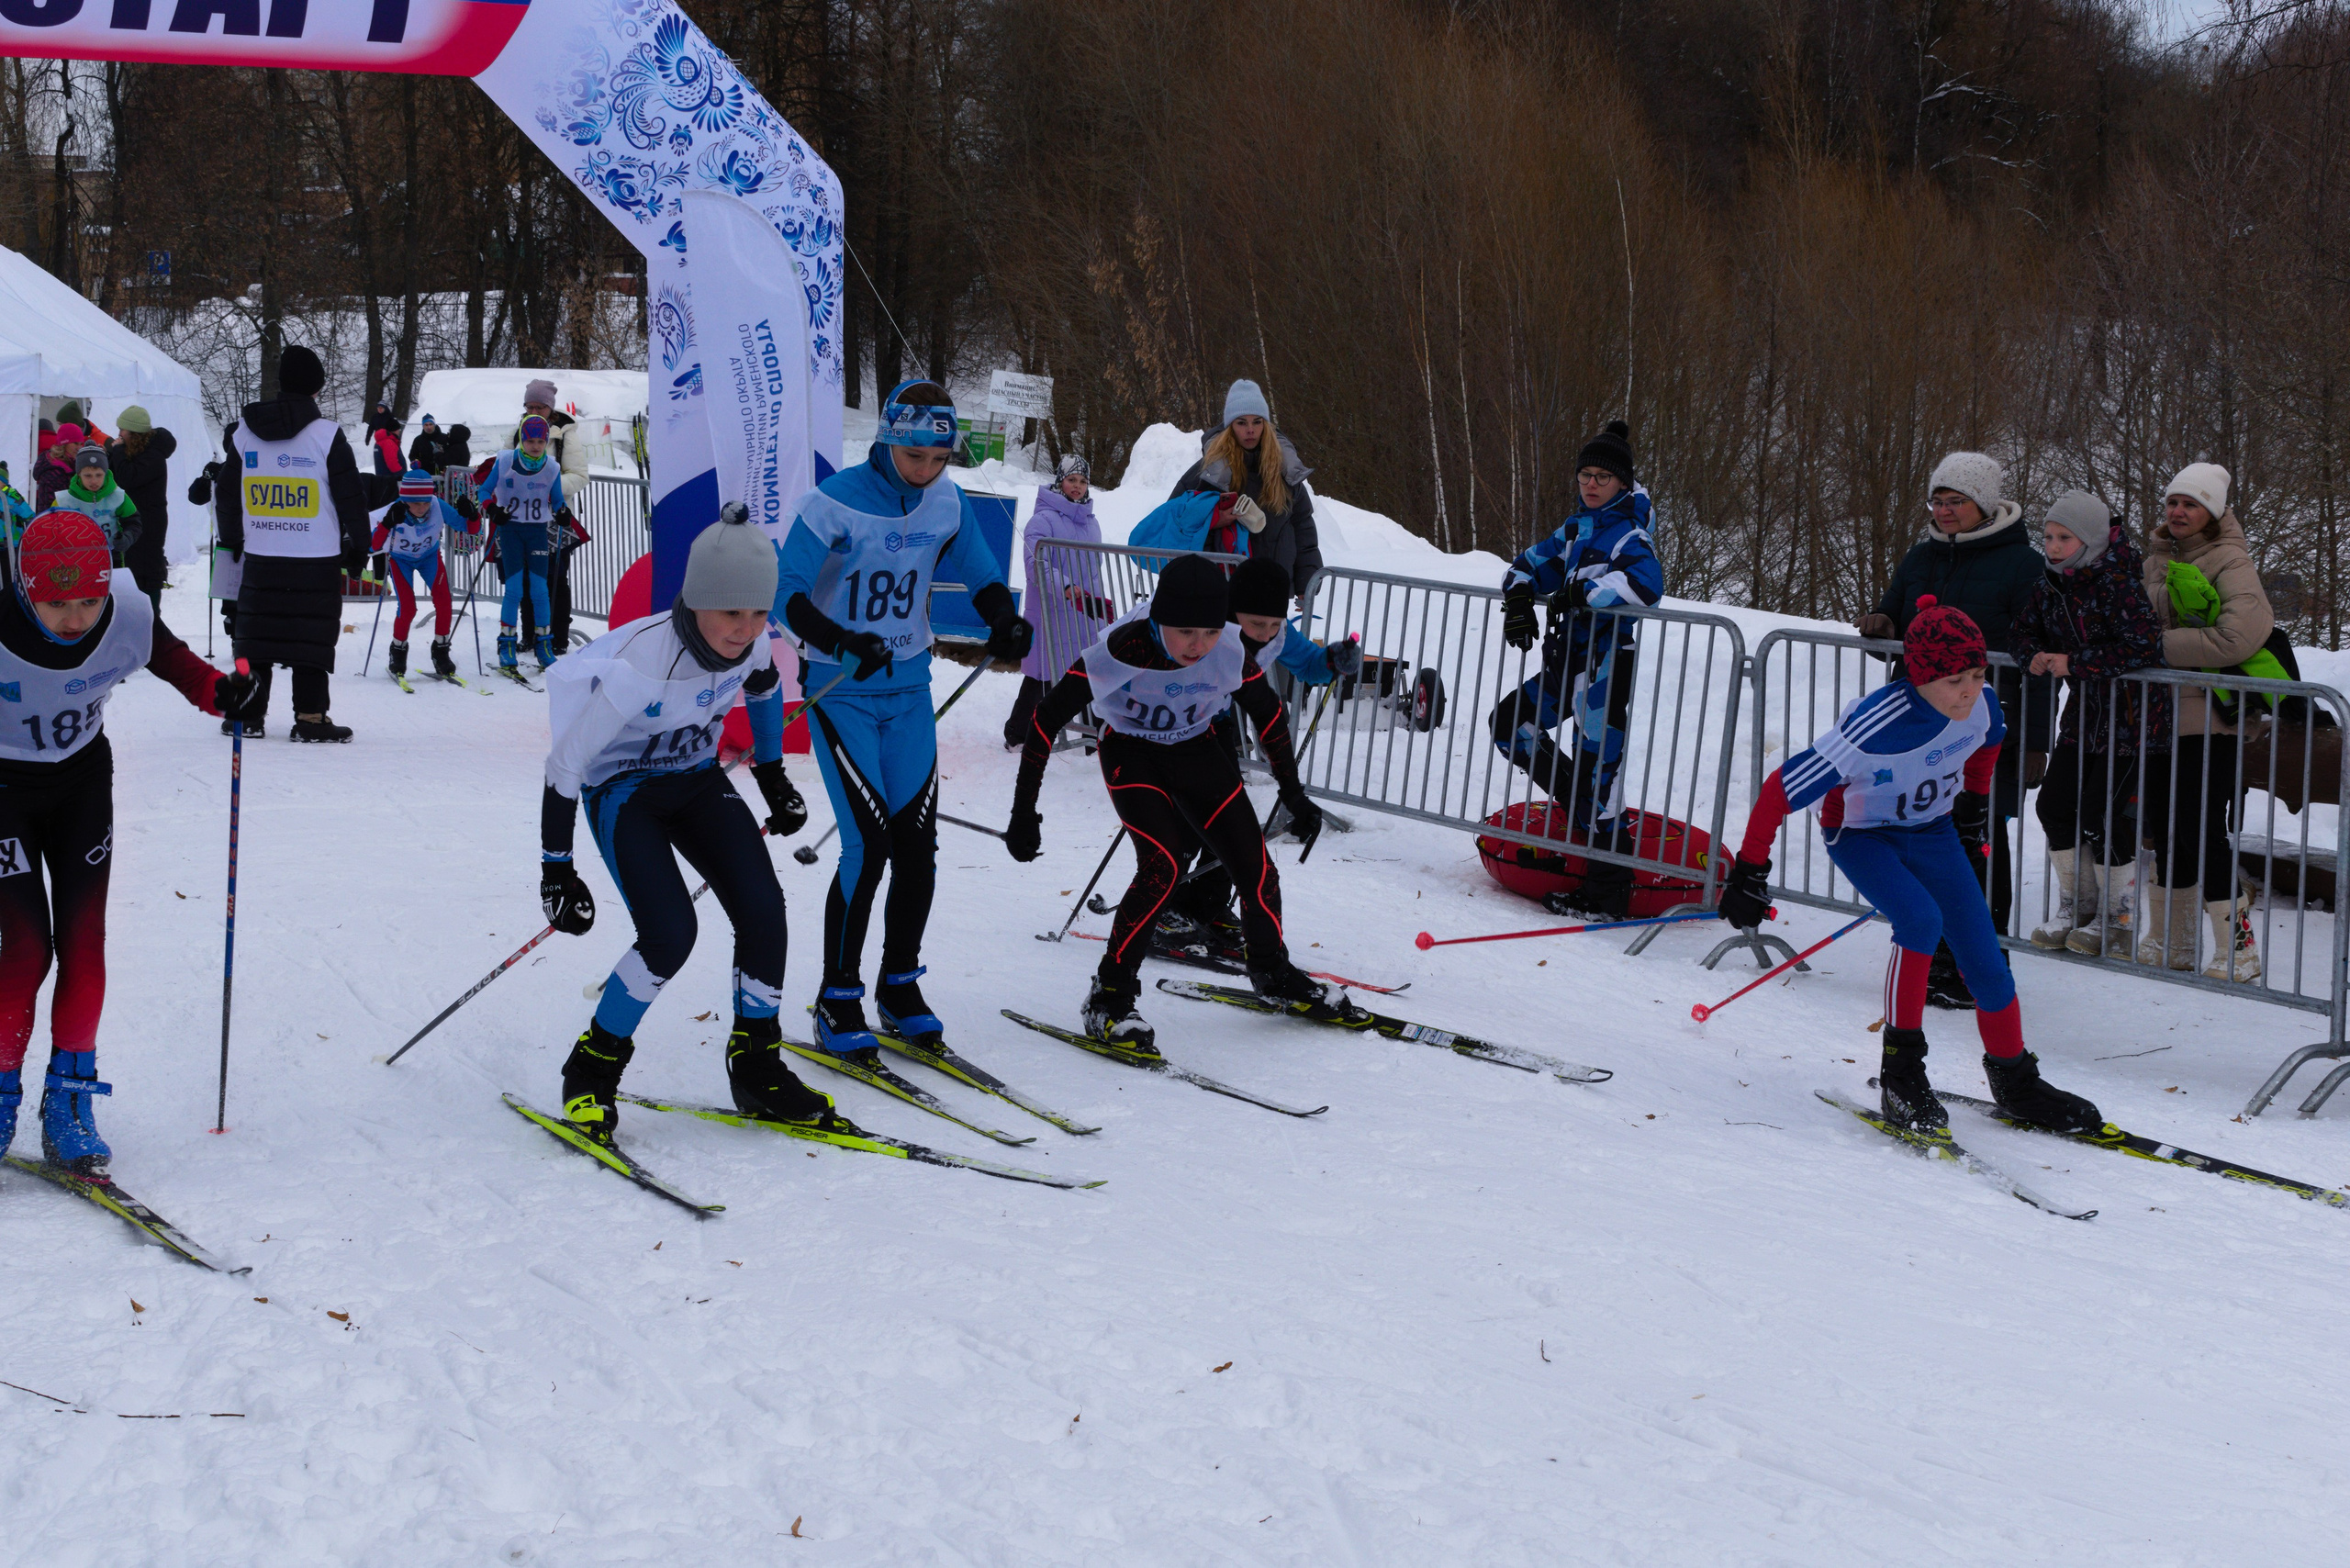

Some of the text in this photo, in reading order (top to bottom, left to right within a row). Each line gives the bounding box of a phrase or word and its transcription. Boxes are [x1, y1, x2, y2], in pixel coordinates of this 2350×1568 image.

[250, 483, 308, 510] СУДЬЯ
[509, 497, 542, 521] 218
[251, 521, 310, 532] РАМЕНСКОЕ
[845, 569, 918, 622] 189
[1123, 697, 1198, 731] 201
[1896, 768, 1960, 821] 197
[583, 1045, 619, 1062] FISCHER
[905, 1045, 940, 1067] FISCHER
[838, 1062, 874, 1083] FISCHER
[62, 1081, 98, 1092] SPINE
[574, 1135, 591, 1148] FISCHER
[790, 1127, 829, 1140] FISCHER
